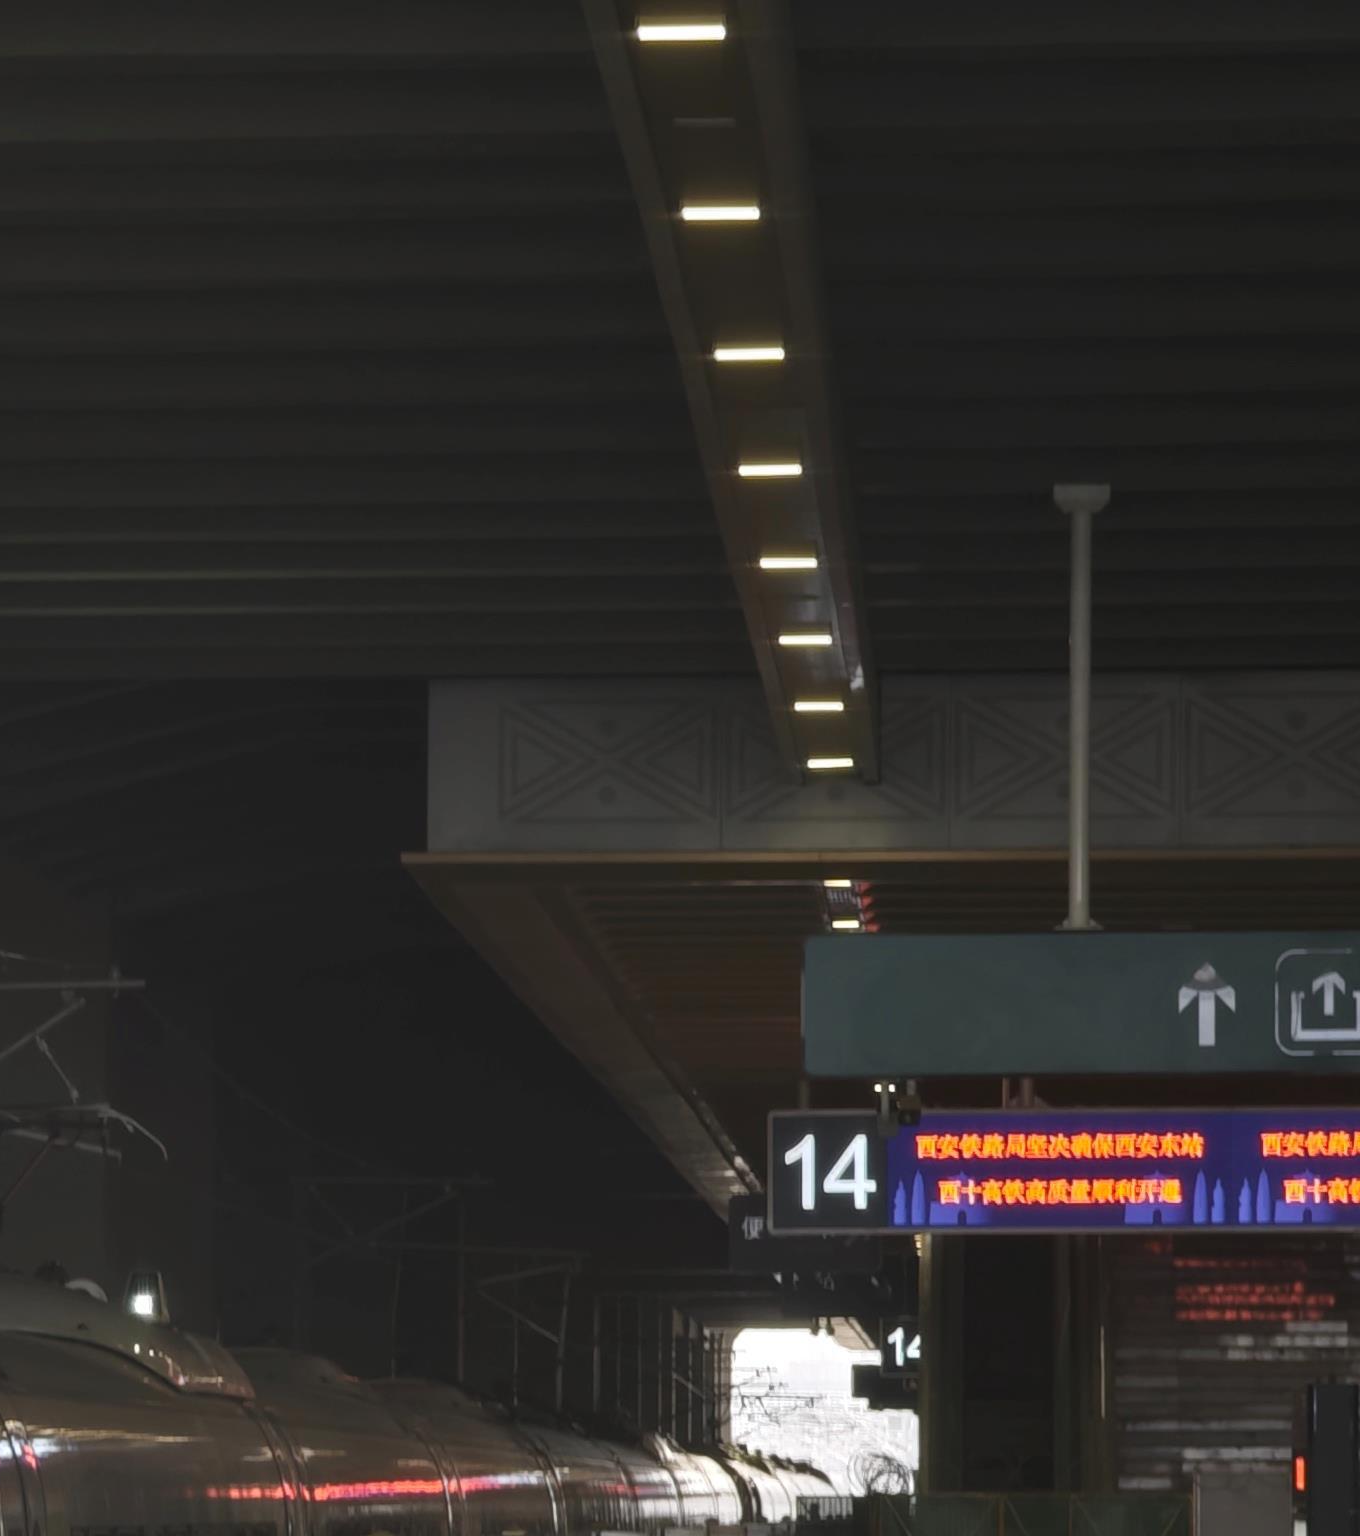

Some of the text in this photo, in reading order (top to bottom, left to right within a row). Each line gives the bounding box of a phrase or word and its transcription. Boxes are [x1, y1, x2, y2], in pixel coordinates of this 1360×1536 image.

[915, 1132, 1206, 1160] 西安铁路局坚决确保西安东站
[784, 1133, 877, 1211] 14
[938, 1177, 1183, 1205] 西十高铁高质量顺利开通
